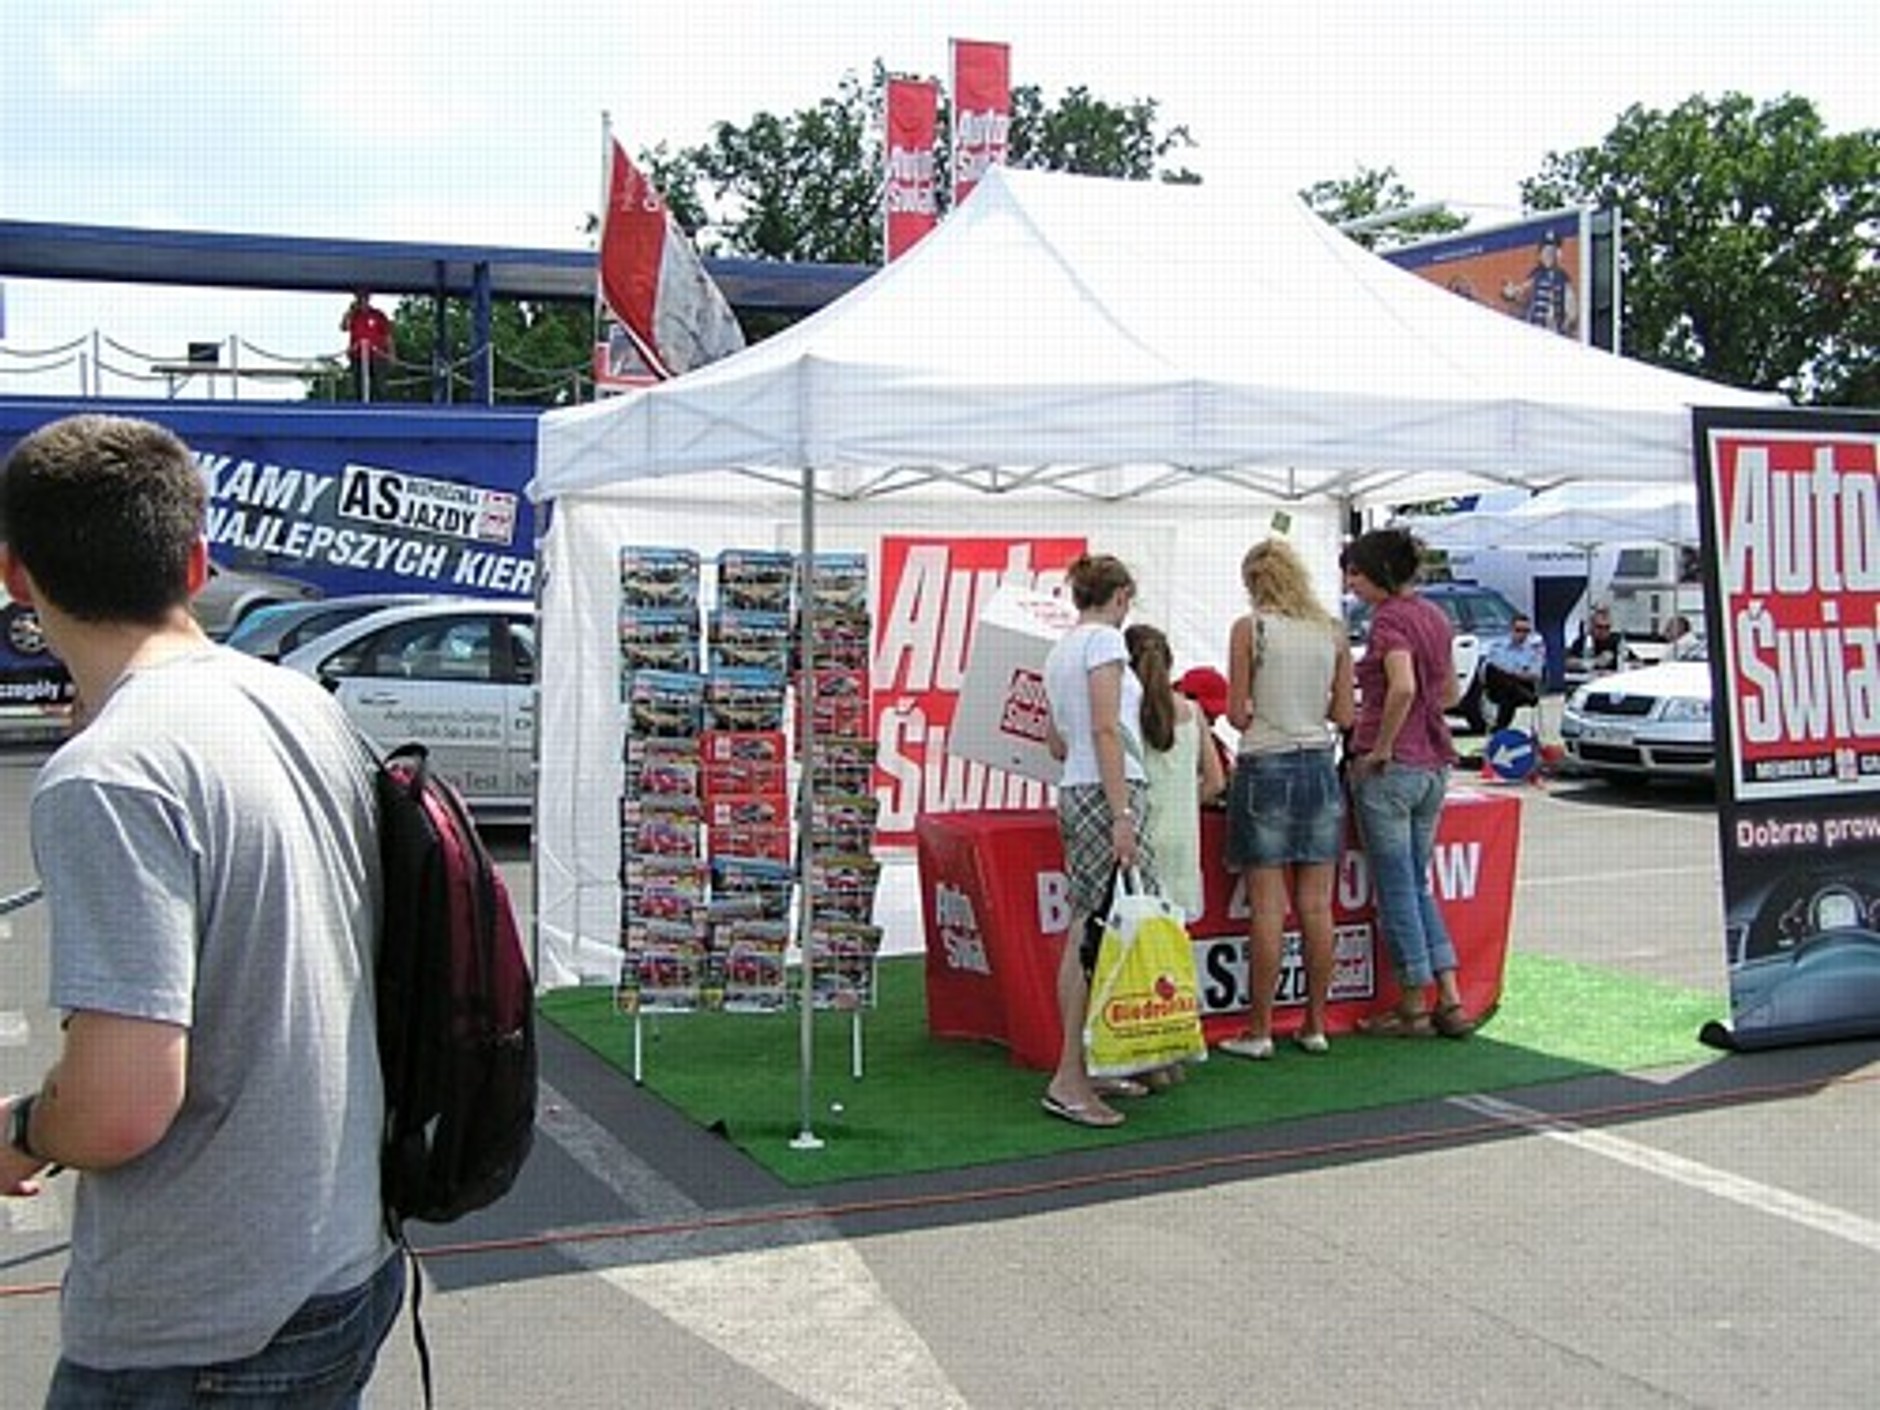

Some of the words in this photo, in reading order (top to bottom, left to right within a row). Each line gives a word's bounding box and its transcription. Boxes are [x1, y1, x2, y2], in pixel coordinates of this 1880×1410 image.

[191, 450, 333, 513] KAMY
[343, 470, 402, 520] AS
[1728, 447, 1880, 594] Auto
[1737, 601, 1880, 743] Świa
[1737, 818, 1818, 848] Dobrze
